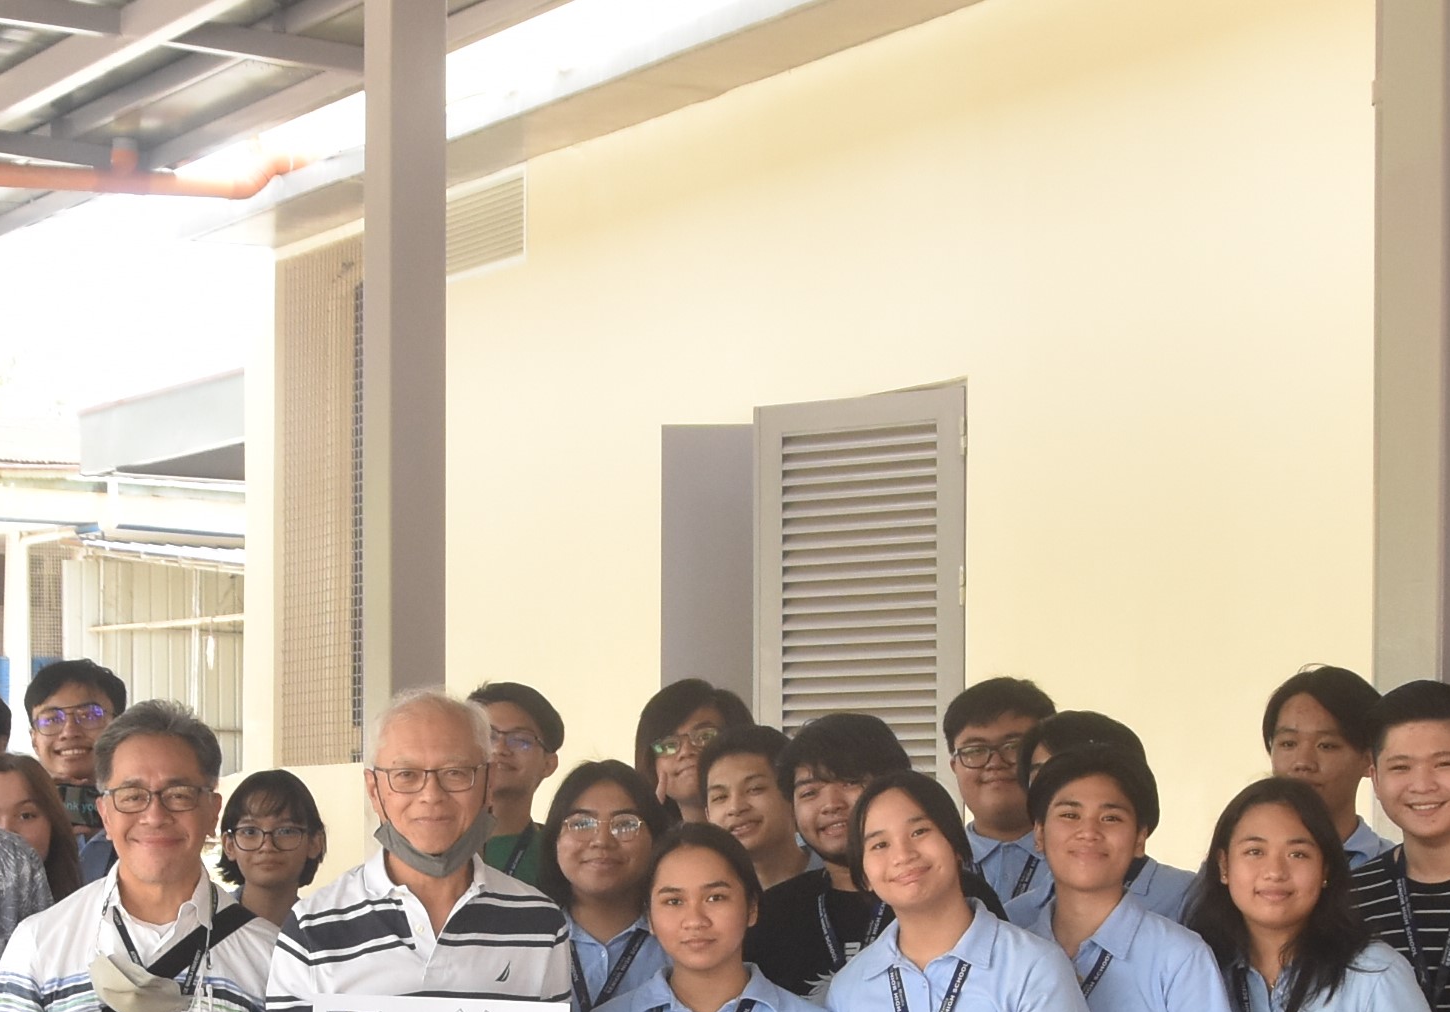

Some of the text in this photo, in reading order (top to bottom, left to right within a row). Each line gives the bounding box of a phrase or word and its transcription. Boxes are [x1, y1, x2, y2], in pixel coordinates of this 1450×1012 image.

[873, 917, 881, 935] HIGH
[825, 935, 837, 963] SCHOOL
[1405, 926, 1417, 957] SCHOOL
[952, 963, 968, 993] SCHOOL
[893, 992, 902, 1012] HIGH
